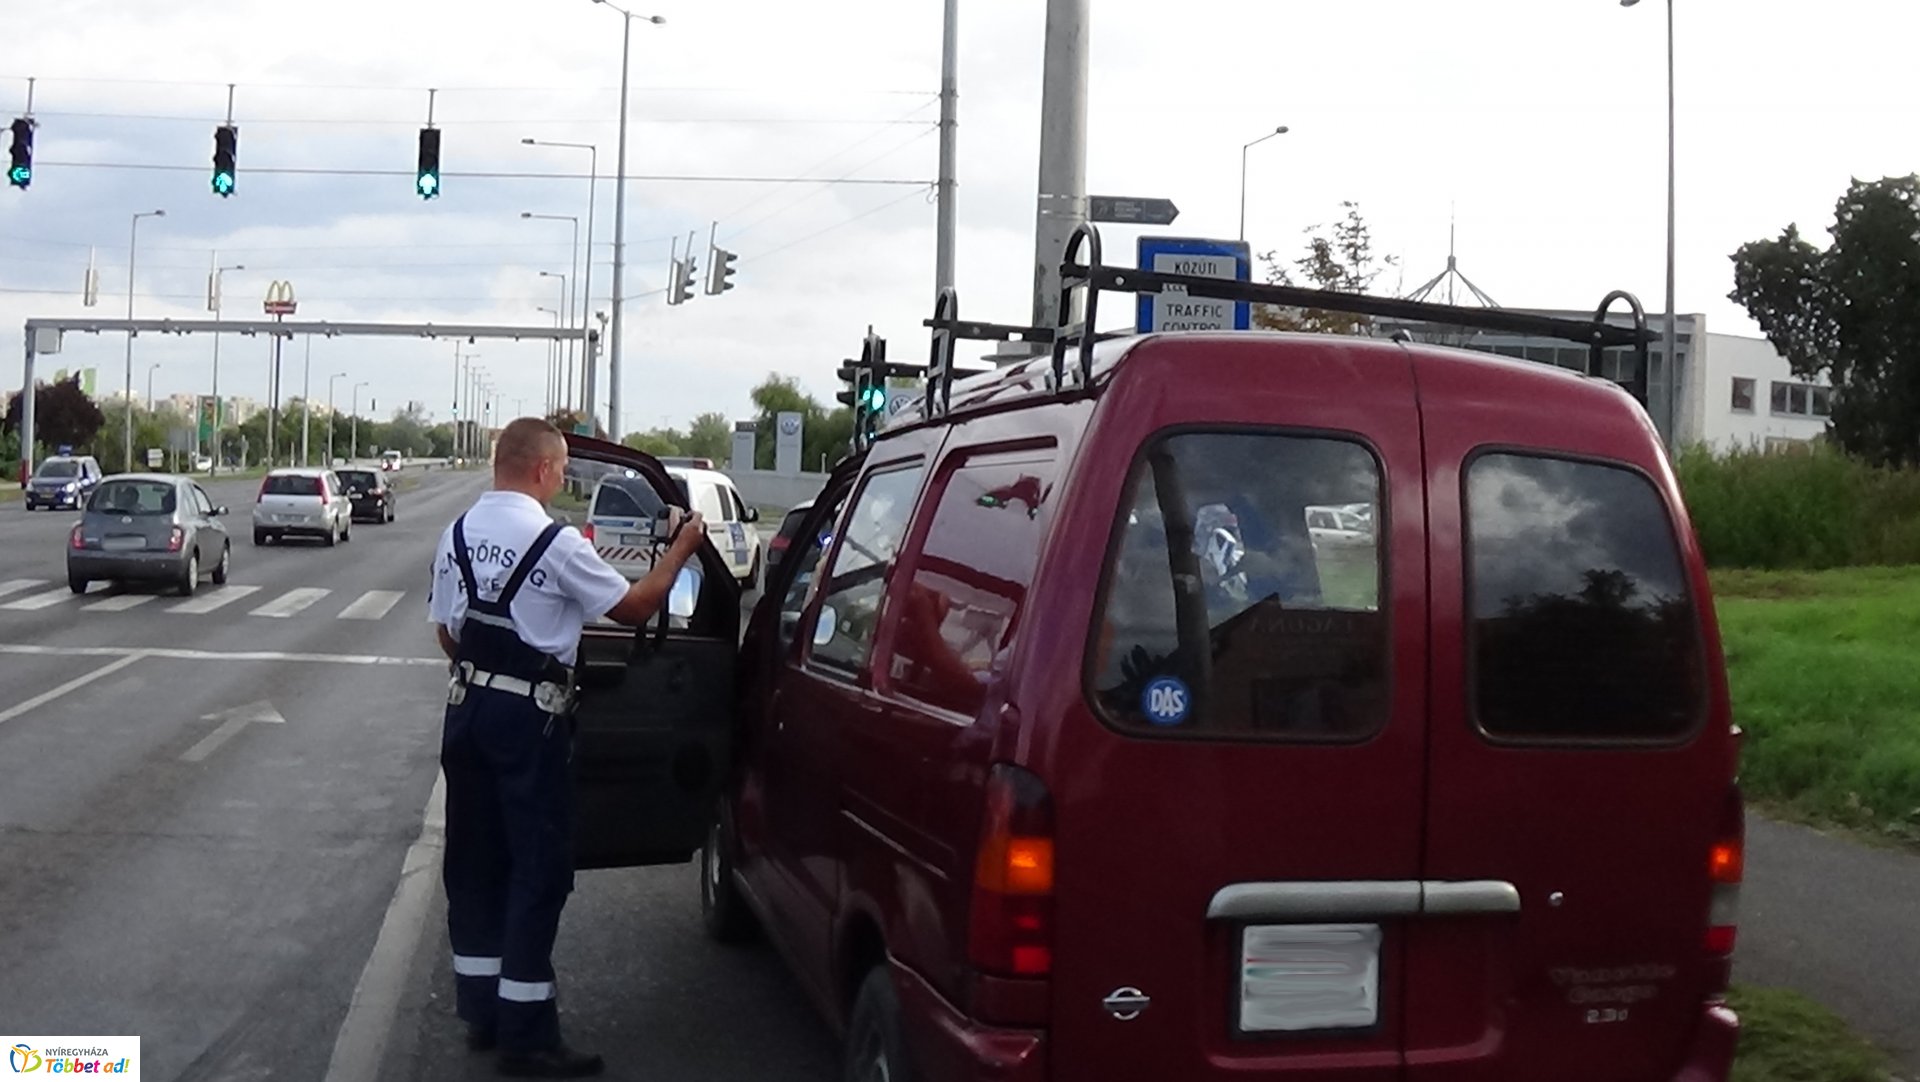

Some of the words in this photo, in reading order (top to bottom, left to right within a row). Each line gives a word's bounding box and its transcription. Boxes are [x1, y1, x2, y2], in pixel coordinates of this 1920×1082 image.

[1166, 303, 1223, 318] TRAFFIC
[439, 539, 547, 588] NDŐRSG
[1150, 686, 1185, 717] DAS
